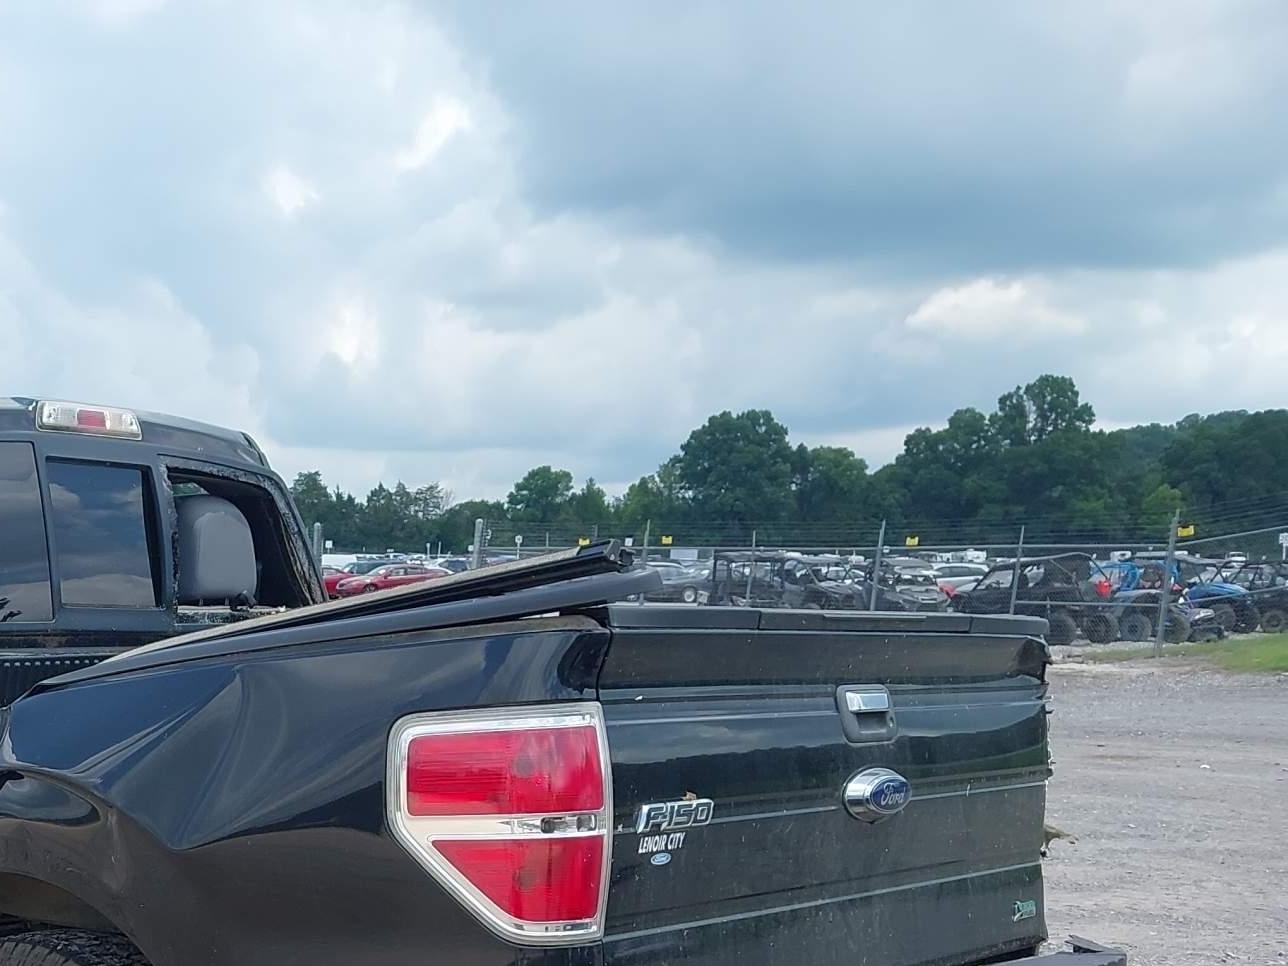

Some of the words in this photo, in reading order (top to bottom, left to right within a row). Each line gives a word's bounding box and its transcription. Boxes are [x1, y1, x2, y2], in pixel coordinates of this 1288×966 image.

[880, 782, 906, 806] Ford
[638, 834, 668, 854] LENOIR
[667, 832, 686, 850] CITY
